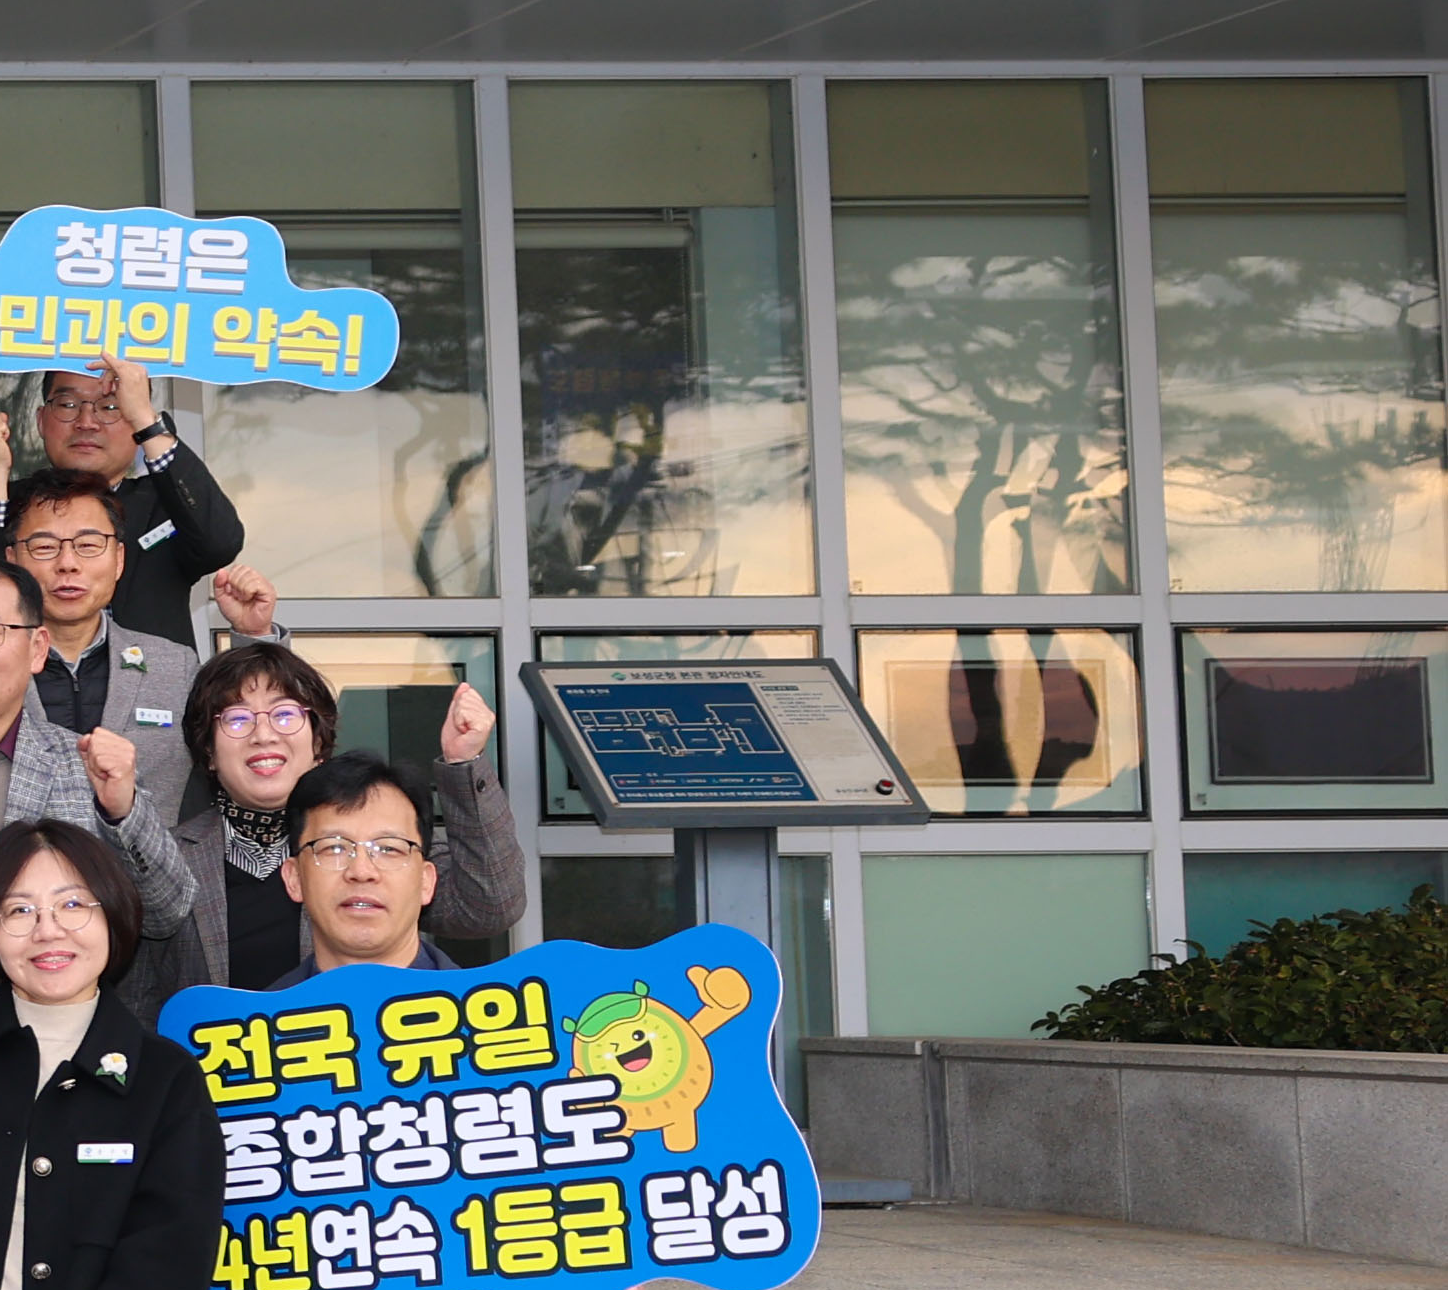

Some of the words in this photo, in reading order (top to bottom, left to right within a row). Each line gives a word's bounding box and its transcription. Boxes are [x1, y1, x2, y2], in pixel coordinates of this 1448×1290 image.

[55, 222, 249, 294] 청렴은
[213, 305, 364, 376] 약속!
[189, 1005, 358, 1104] 전국
[378, 976, 555, 1086] 유일
[452, 1177, 630, 1277] 1등급
[641, 1161, 791, 1263] 달성
